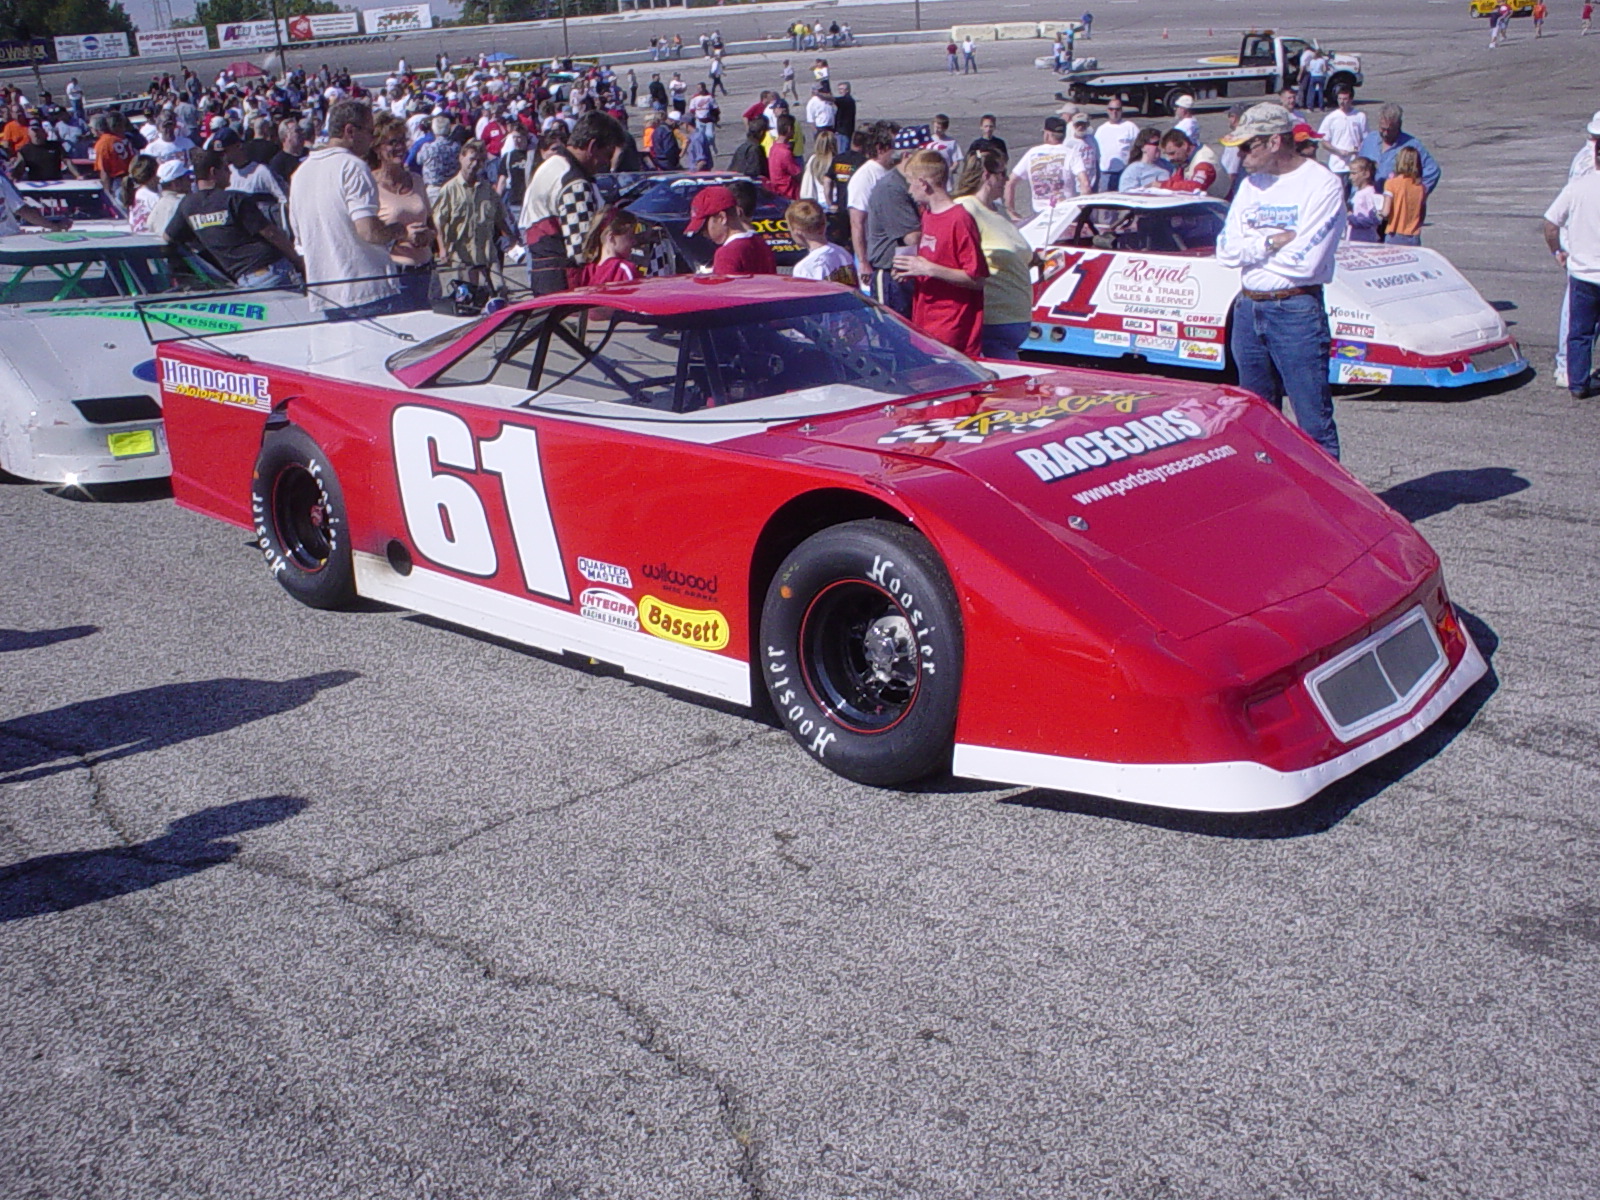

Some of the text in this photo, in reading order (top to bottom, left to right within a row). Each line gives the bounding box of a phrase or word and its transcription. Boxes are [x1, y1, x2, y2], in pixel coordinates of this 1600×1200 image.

[317, 35, 388, 47] SPEEDWAY
[1124, 258, 1190, 285] Royal
[1113, 293, 1194, 305] SALES & SERVICE
[1114, 283, 1195, 297] TRUCK & TRAILER
[164, 313, 240, 331] Presses
[1016, 409, 1202, 482] RACECARS
[1071, 444, 1238, 506] www.portcityracecars.com
[391, 403, 574, 605] 61
[579, 558, 627, 576] QUARTER
[588, 569, 630, 586] MASTER
[642, 562, 718, 594] wilwood
[582, 594, 636, 616] INTEGRA
[865, 554, 936, 675] Hoosier
[582, 608, 637, 630] RACING SPRINGS
[648, 604, 719, 643] Bassett
[767, 645, 837, 758] Hoosier
